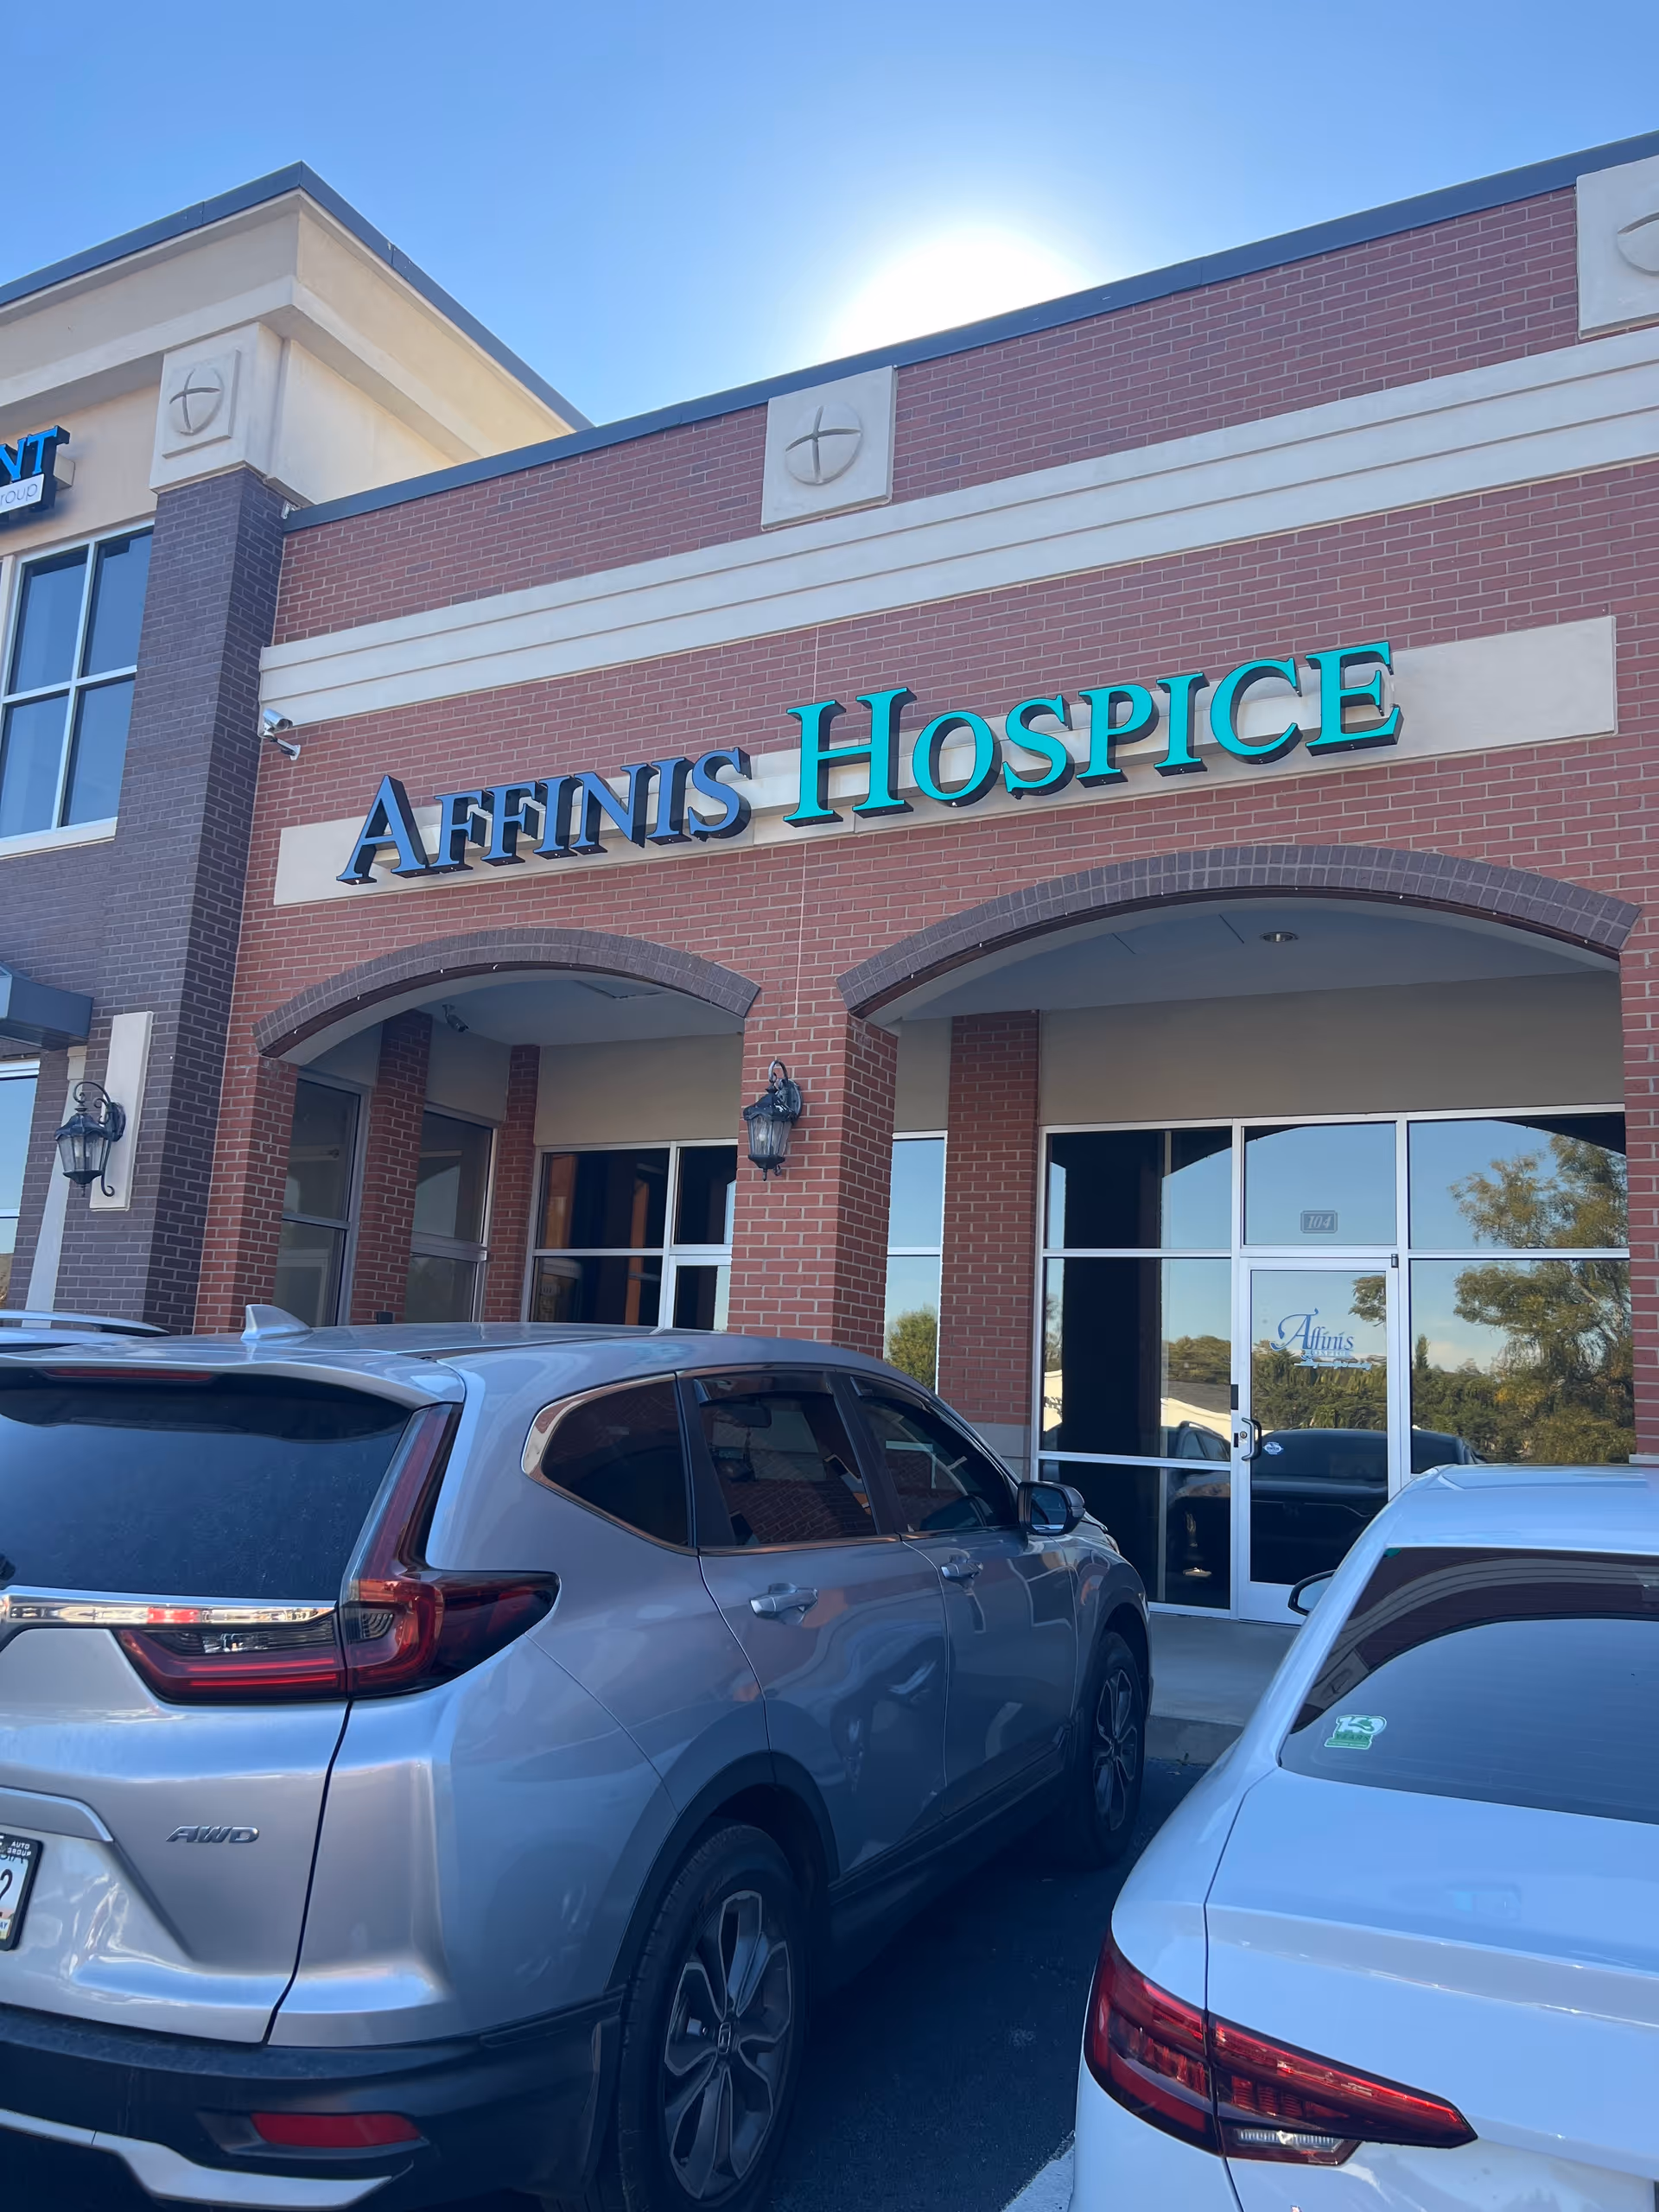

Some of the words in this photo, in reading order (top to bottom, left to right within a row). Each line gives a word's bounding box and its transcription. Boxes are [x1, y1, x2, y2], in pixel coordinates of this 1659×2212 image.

[336, 747, 750, 885] AFFINIS
[783, 641, 1402, 827] HOSPICE
[1306, 1215, 1333, 1229] 104
[1270, 1307, 1354, 1351] Affinis
[165, 1825, 259, 1843] AWD
[7, 1847, 32, 1857] GROUP
[11, 1840, 30, 1850] AUTO
